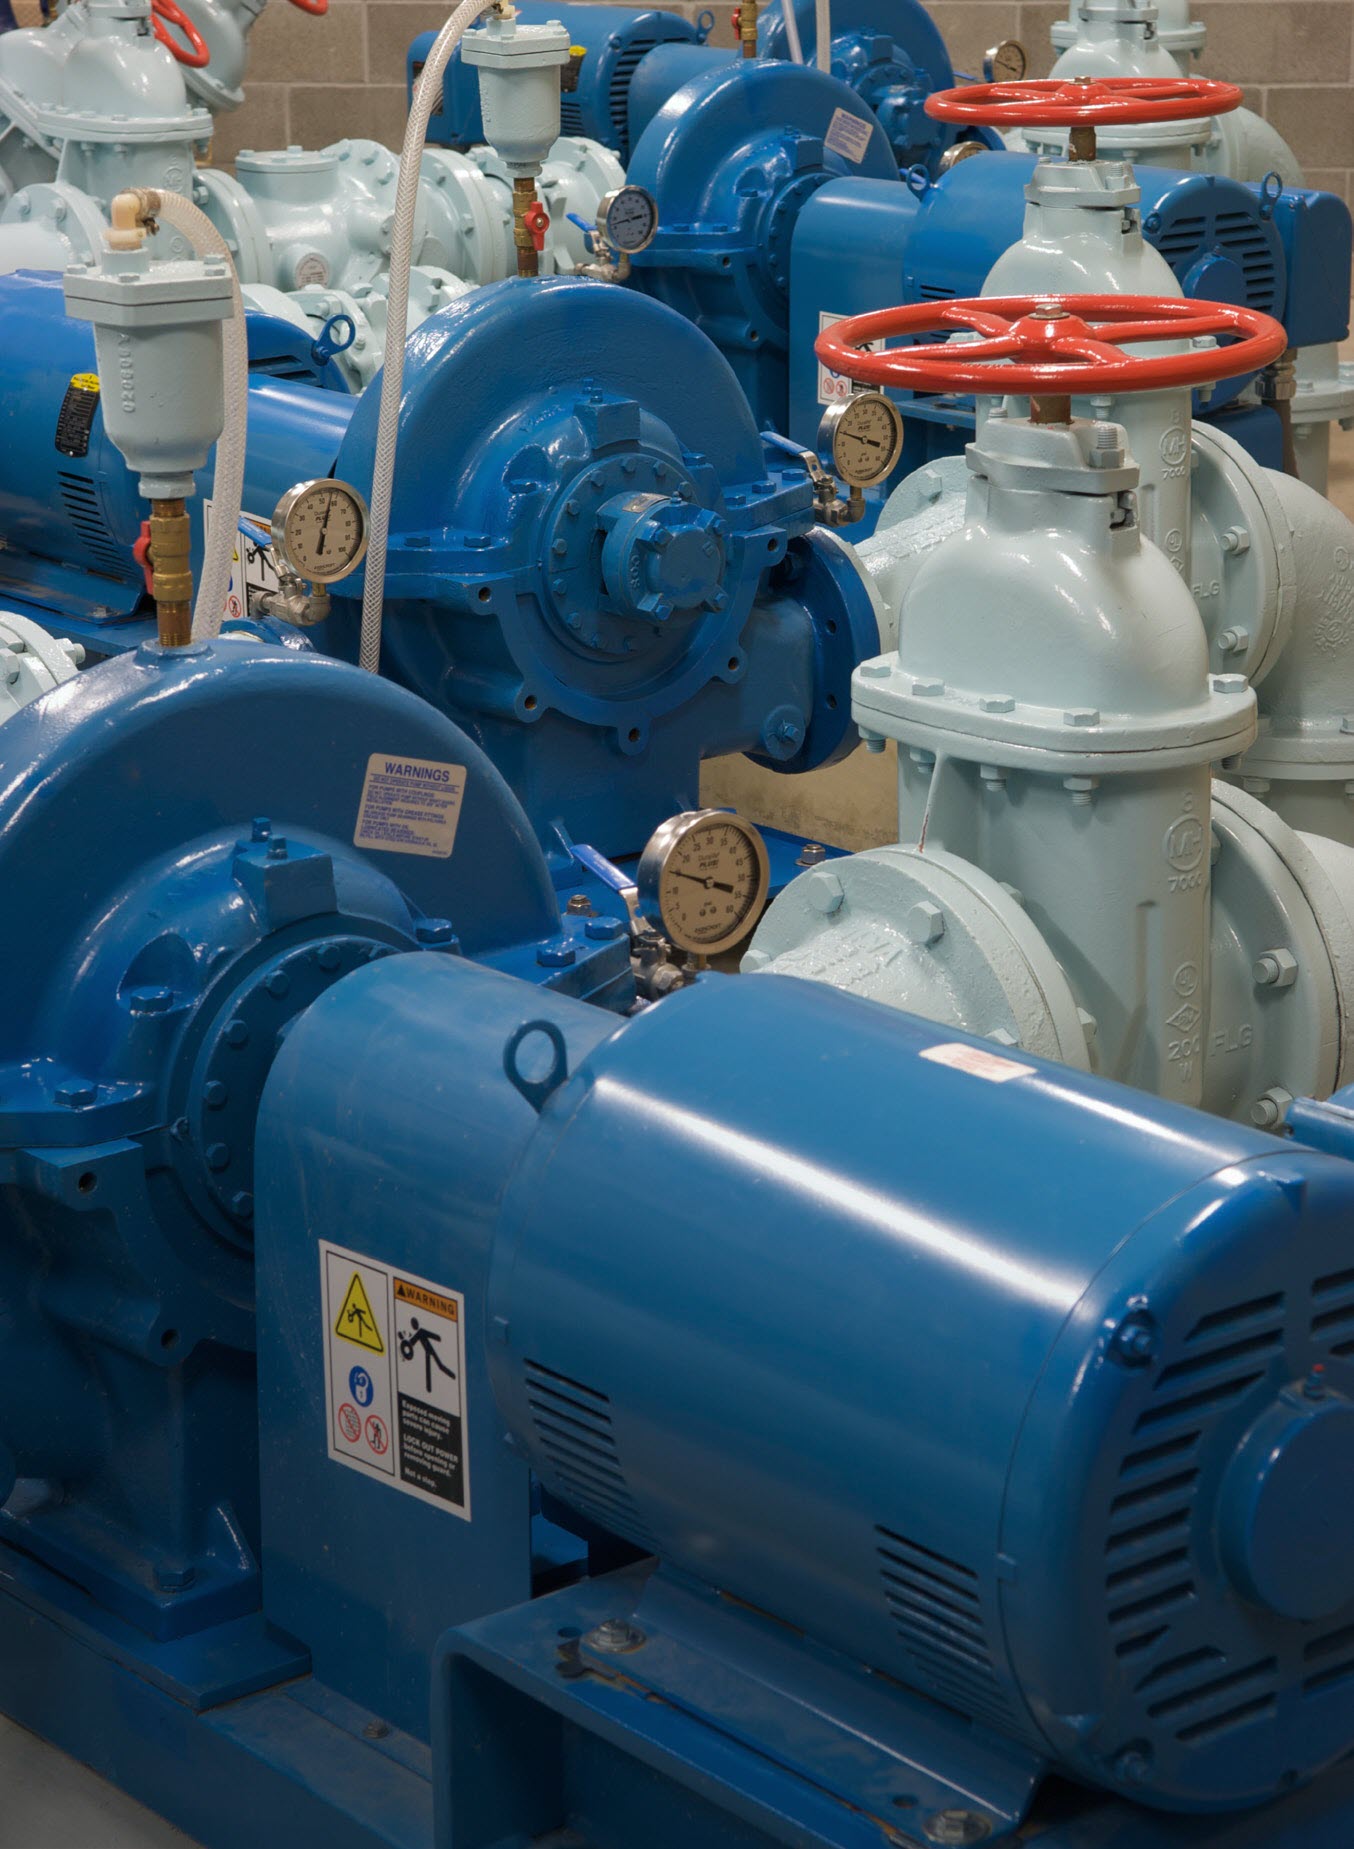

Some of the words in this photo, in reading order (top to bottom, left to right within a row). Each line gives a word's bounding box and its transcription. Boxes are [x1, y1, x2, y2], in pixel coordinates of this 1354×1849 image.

[319, 497, 325, 505] 50
[385, 762, 450, 782] WARNINGS
[706, 836, 714, 845] 30
[720, 837, 728, 846] 35
[693, 843, 701, 852] 25
[729, 846, 737, 855] 40
[683, 853, 690, 863] 20
[736, 858, 744, 866] 45
[738, 873, 745, 882] 50
[734, 890, 742, 899] 55
[726, 905, 734, 914] 60
[1209, 1024, 1253, 1057] FLG
[406, 1287, 454, 1315] WARNING
[403, 1432, 420, 1447] LOCK
[421, 1441, 434, 1453] OUT
[435, 1447, 458, 1464] POWER
